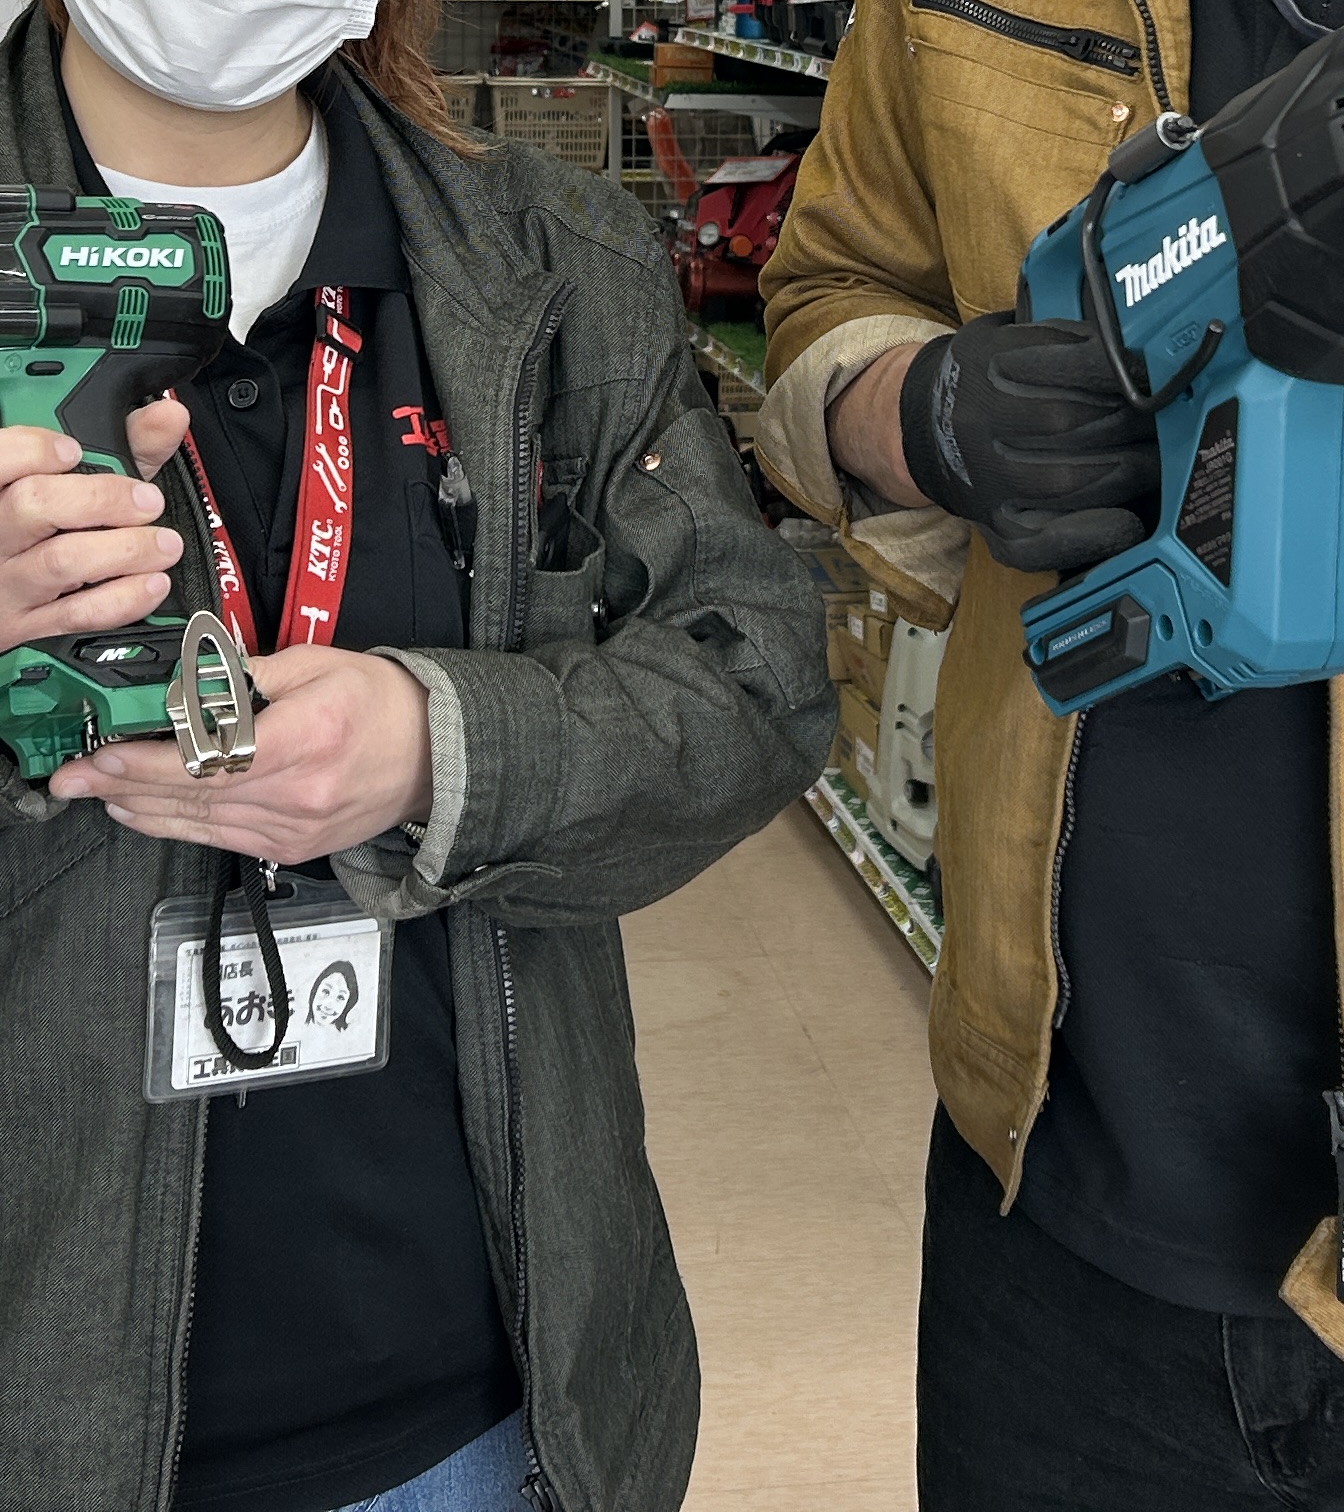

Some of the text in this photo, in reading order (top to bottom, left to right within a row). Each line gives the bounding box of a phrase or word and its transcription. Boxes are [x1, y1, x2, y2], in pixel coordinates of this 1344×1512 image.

[59, 246, 185, 268] HiKOKI
[307, 519, 333, 581] KTC
[328, 524, 343, 583] KYOTO TOOL
